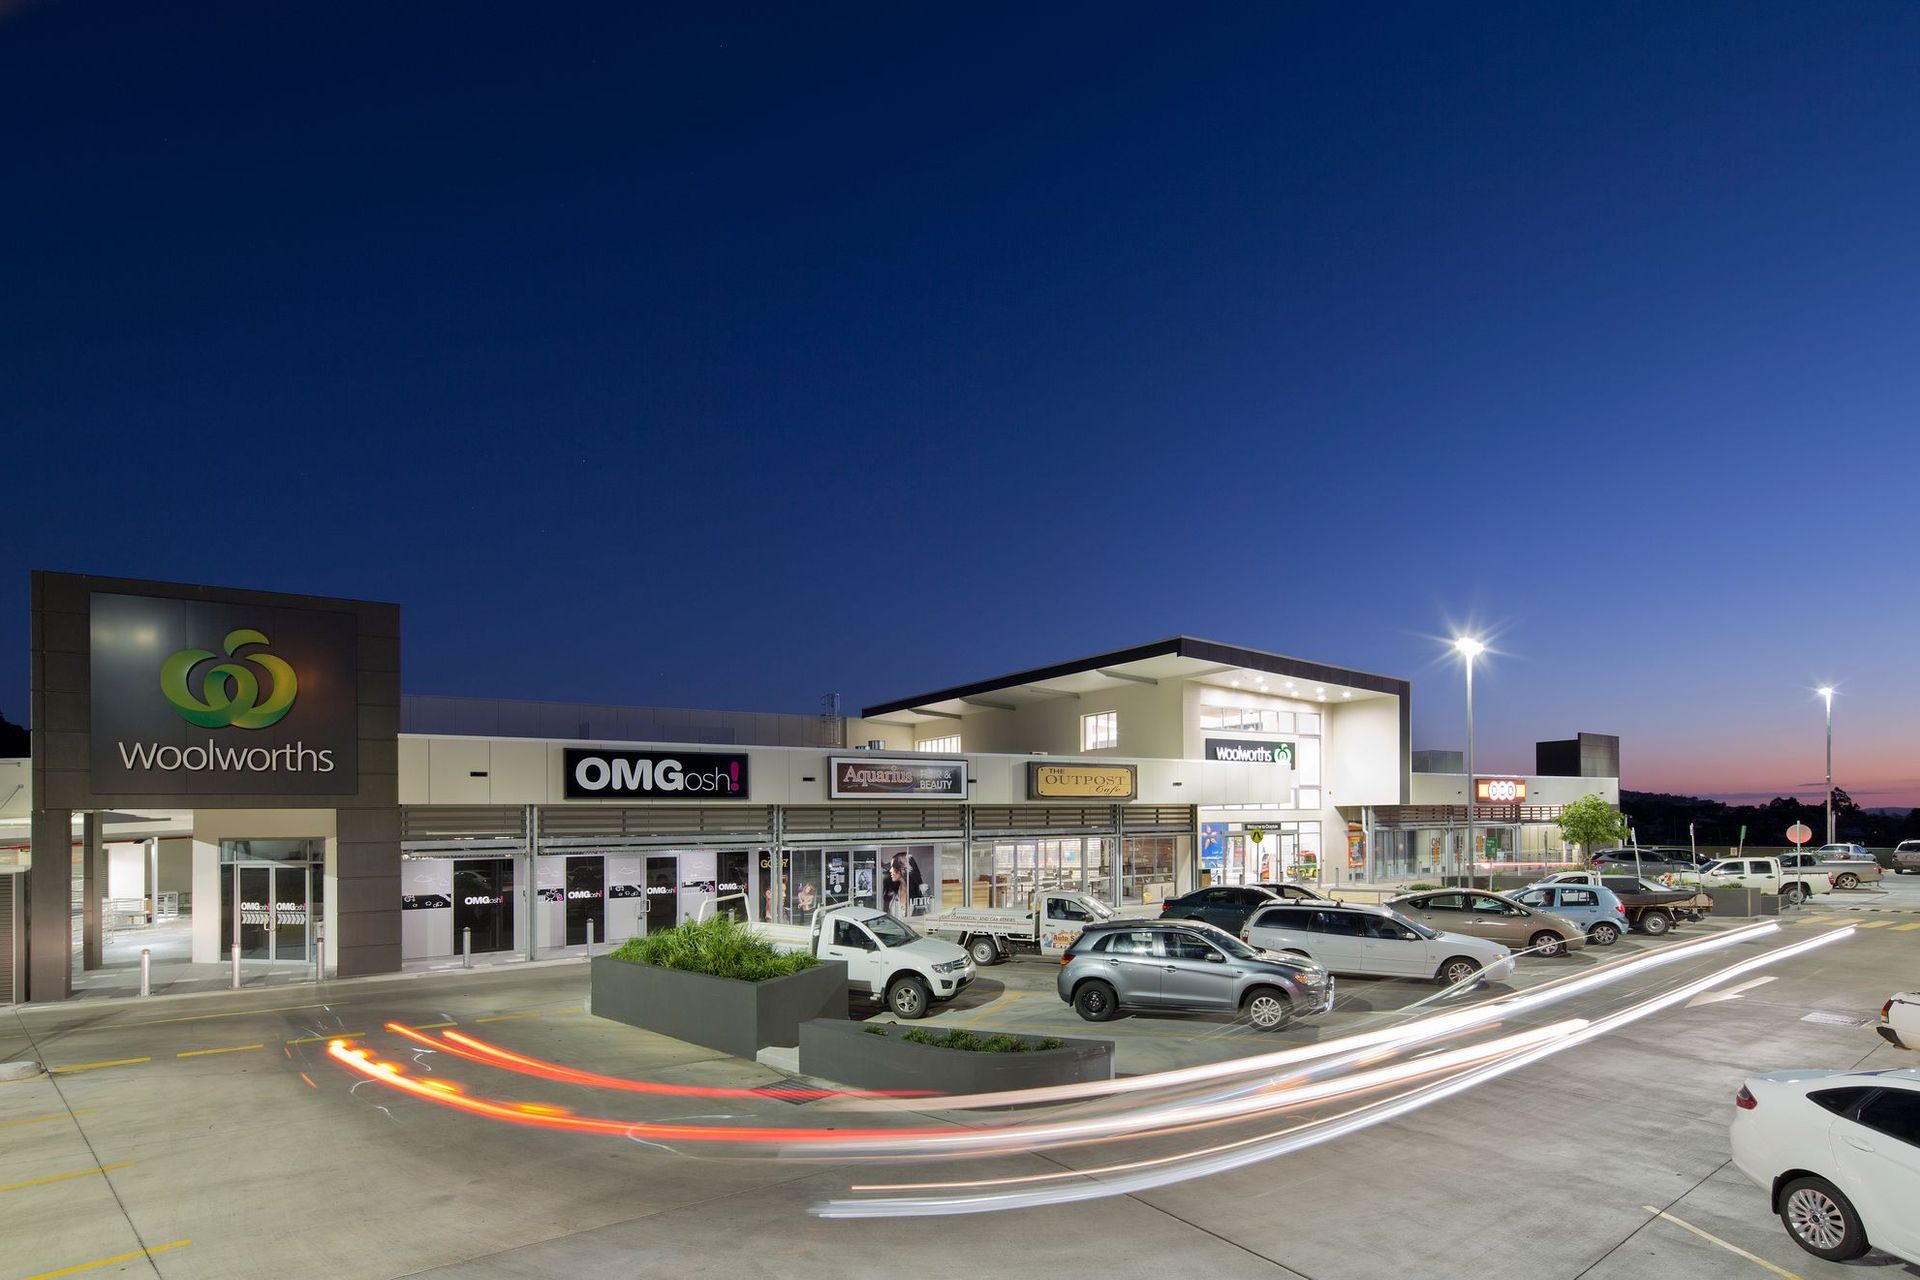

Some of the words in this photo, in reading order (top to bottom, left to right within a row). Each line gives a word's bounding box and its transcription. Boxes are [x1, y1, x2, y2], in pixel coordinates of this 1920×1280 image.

[118, 738, 335, 773] Woolworths
[1216, 745, 1273, 762] Woolworths
[575, 756, 740, 792] OMGosh!
[843, 765, 913, 787] Aquarius
[944, 769, 952, 779] &
[1045, 775, 1126, 786] OUTPOST
[920, 780, 952, 789] BEAUTY
